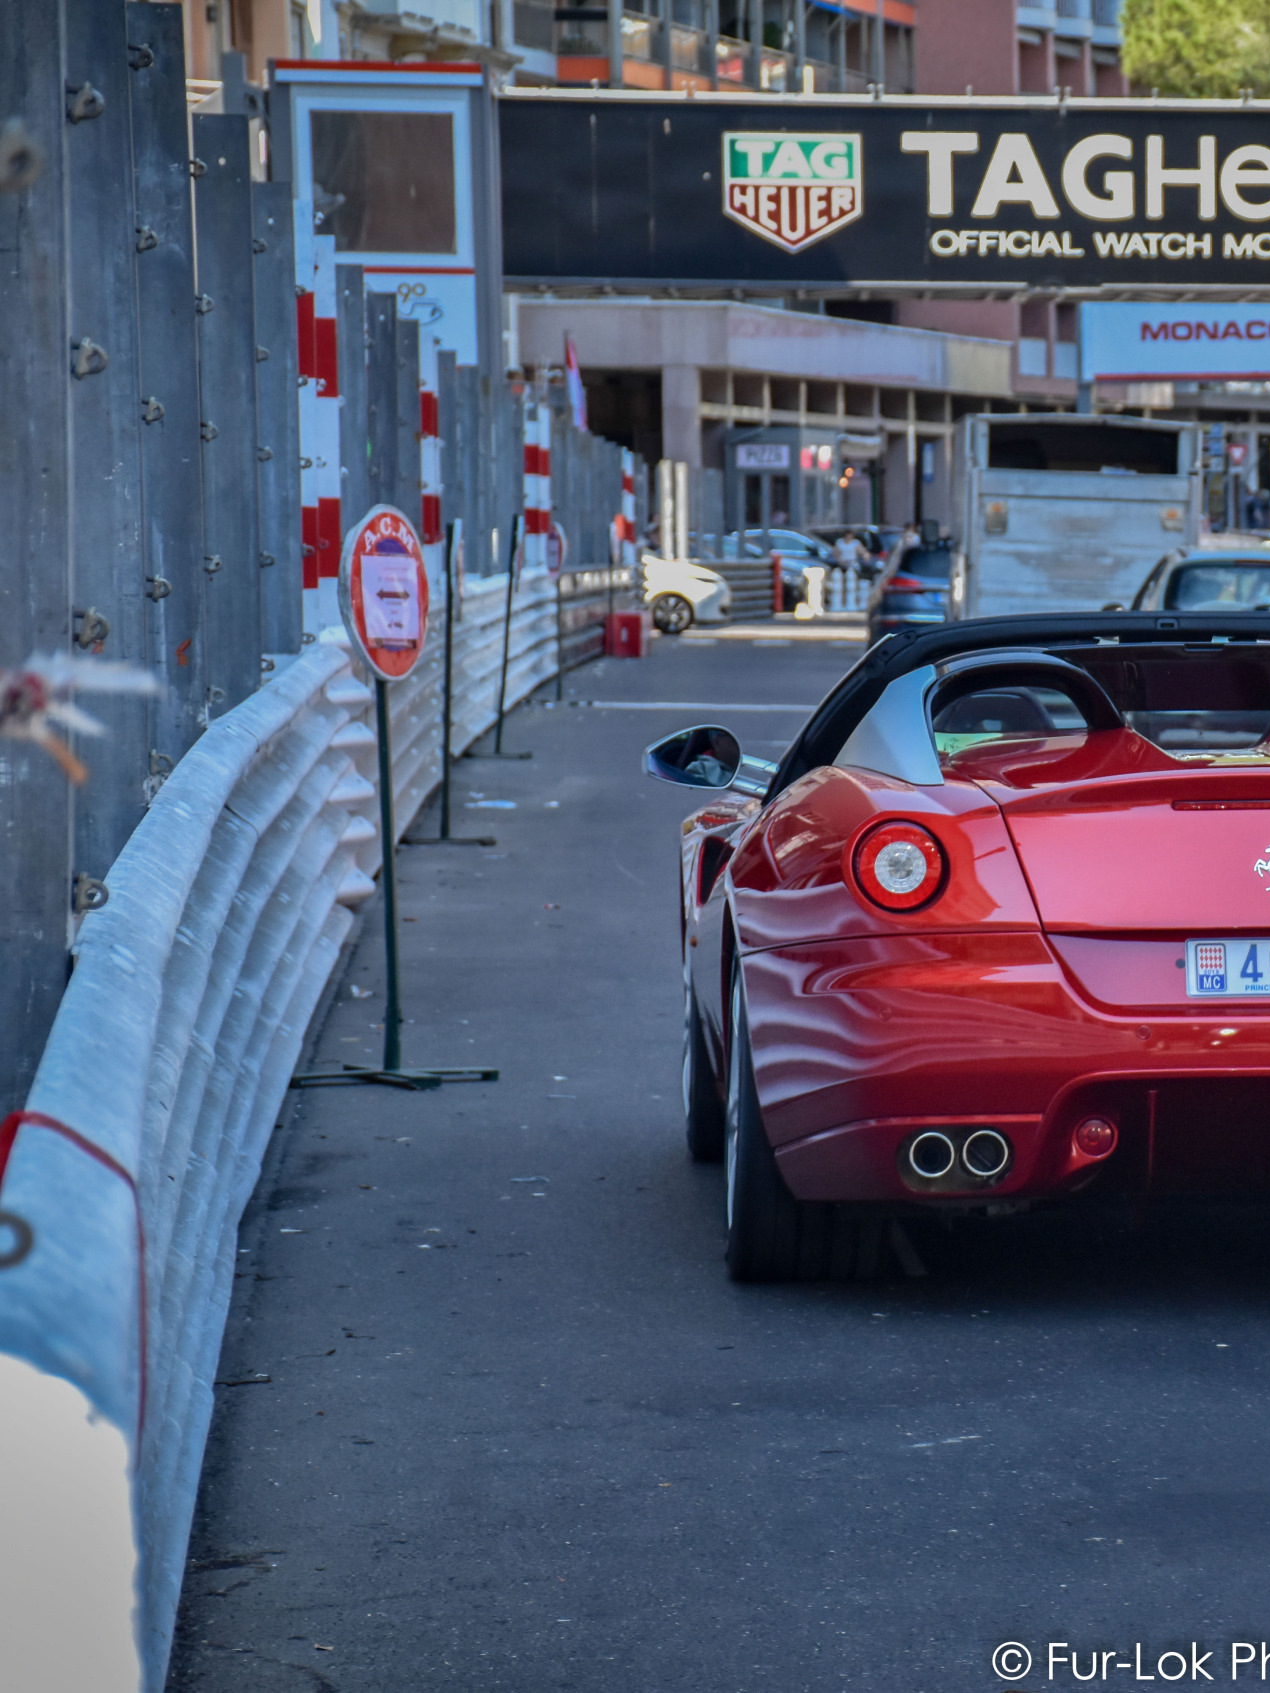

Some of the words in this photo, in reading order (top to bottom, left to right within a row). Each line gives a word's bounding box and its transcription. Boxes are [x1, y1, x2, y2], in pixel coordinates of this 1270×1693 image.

[734, 140, 849, 178] TAG
[733, 185, 853, 240] HEUER
[930, 230, 1083, 258] OFFICIAL
[1093, 231, 1211, 258] WATCH
[1203, 975, 1221, 989] MC
